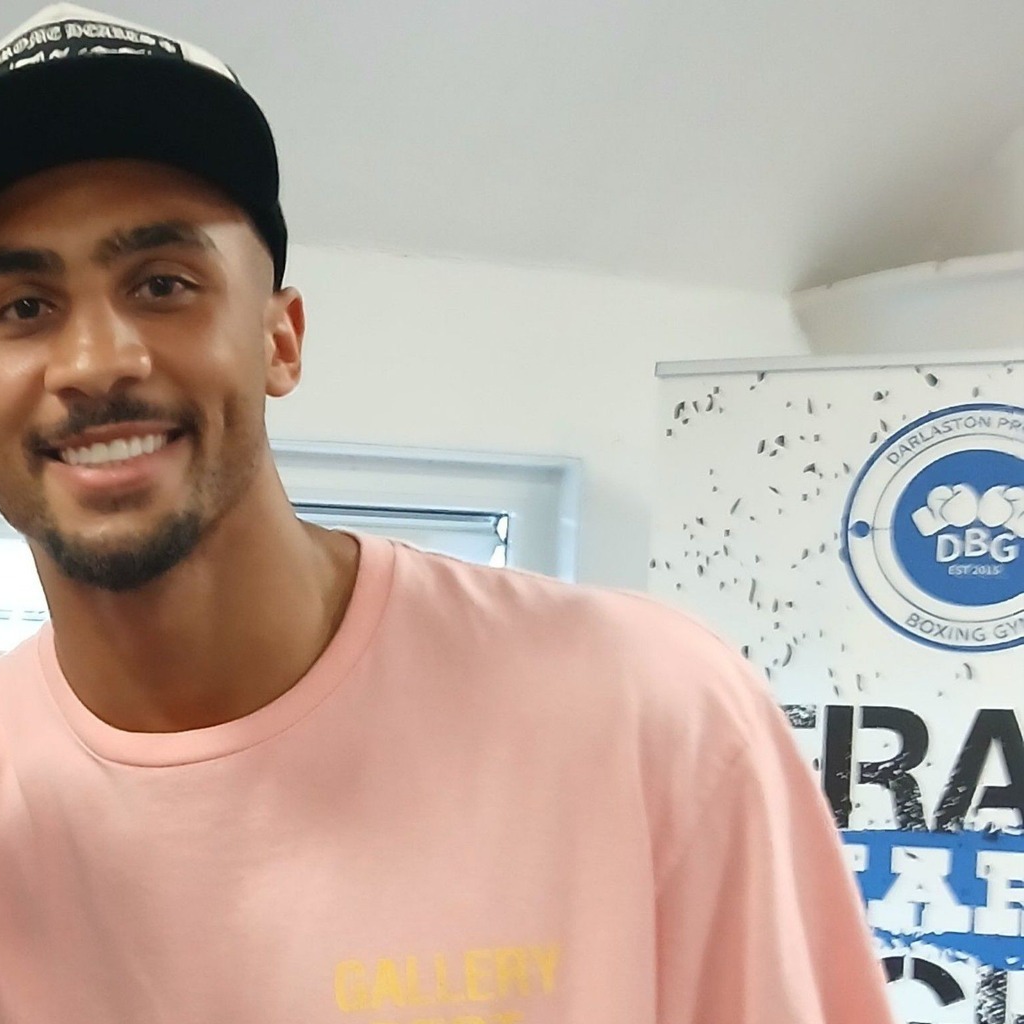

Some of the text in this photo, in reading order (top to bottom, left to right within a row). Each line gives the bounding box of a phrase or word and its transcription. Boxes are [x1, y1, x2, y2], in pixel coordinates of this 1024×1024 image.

[886, 416, 1024, 465] DARLASTON PR
[935, 527, 1020, 563] DBG
[948, 564, 970, 575] EST
[904, 613, 1024, 642] BOXING GY
[780, 705, 1024, 832] RA
[844, 844, 1024, 936] AR
[334, 945, 561, 1013] GALLERY
